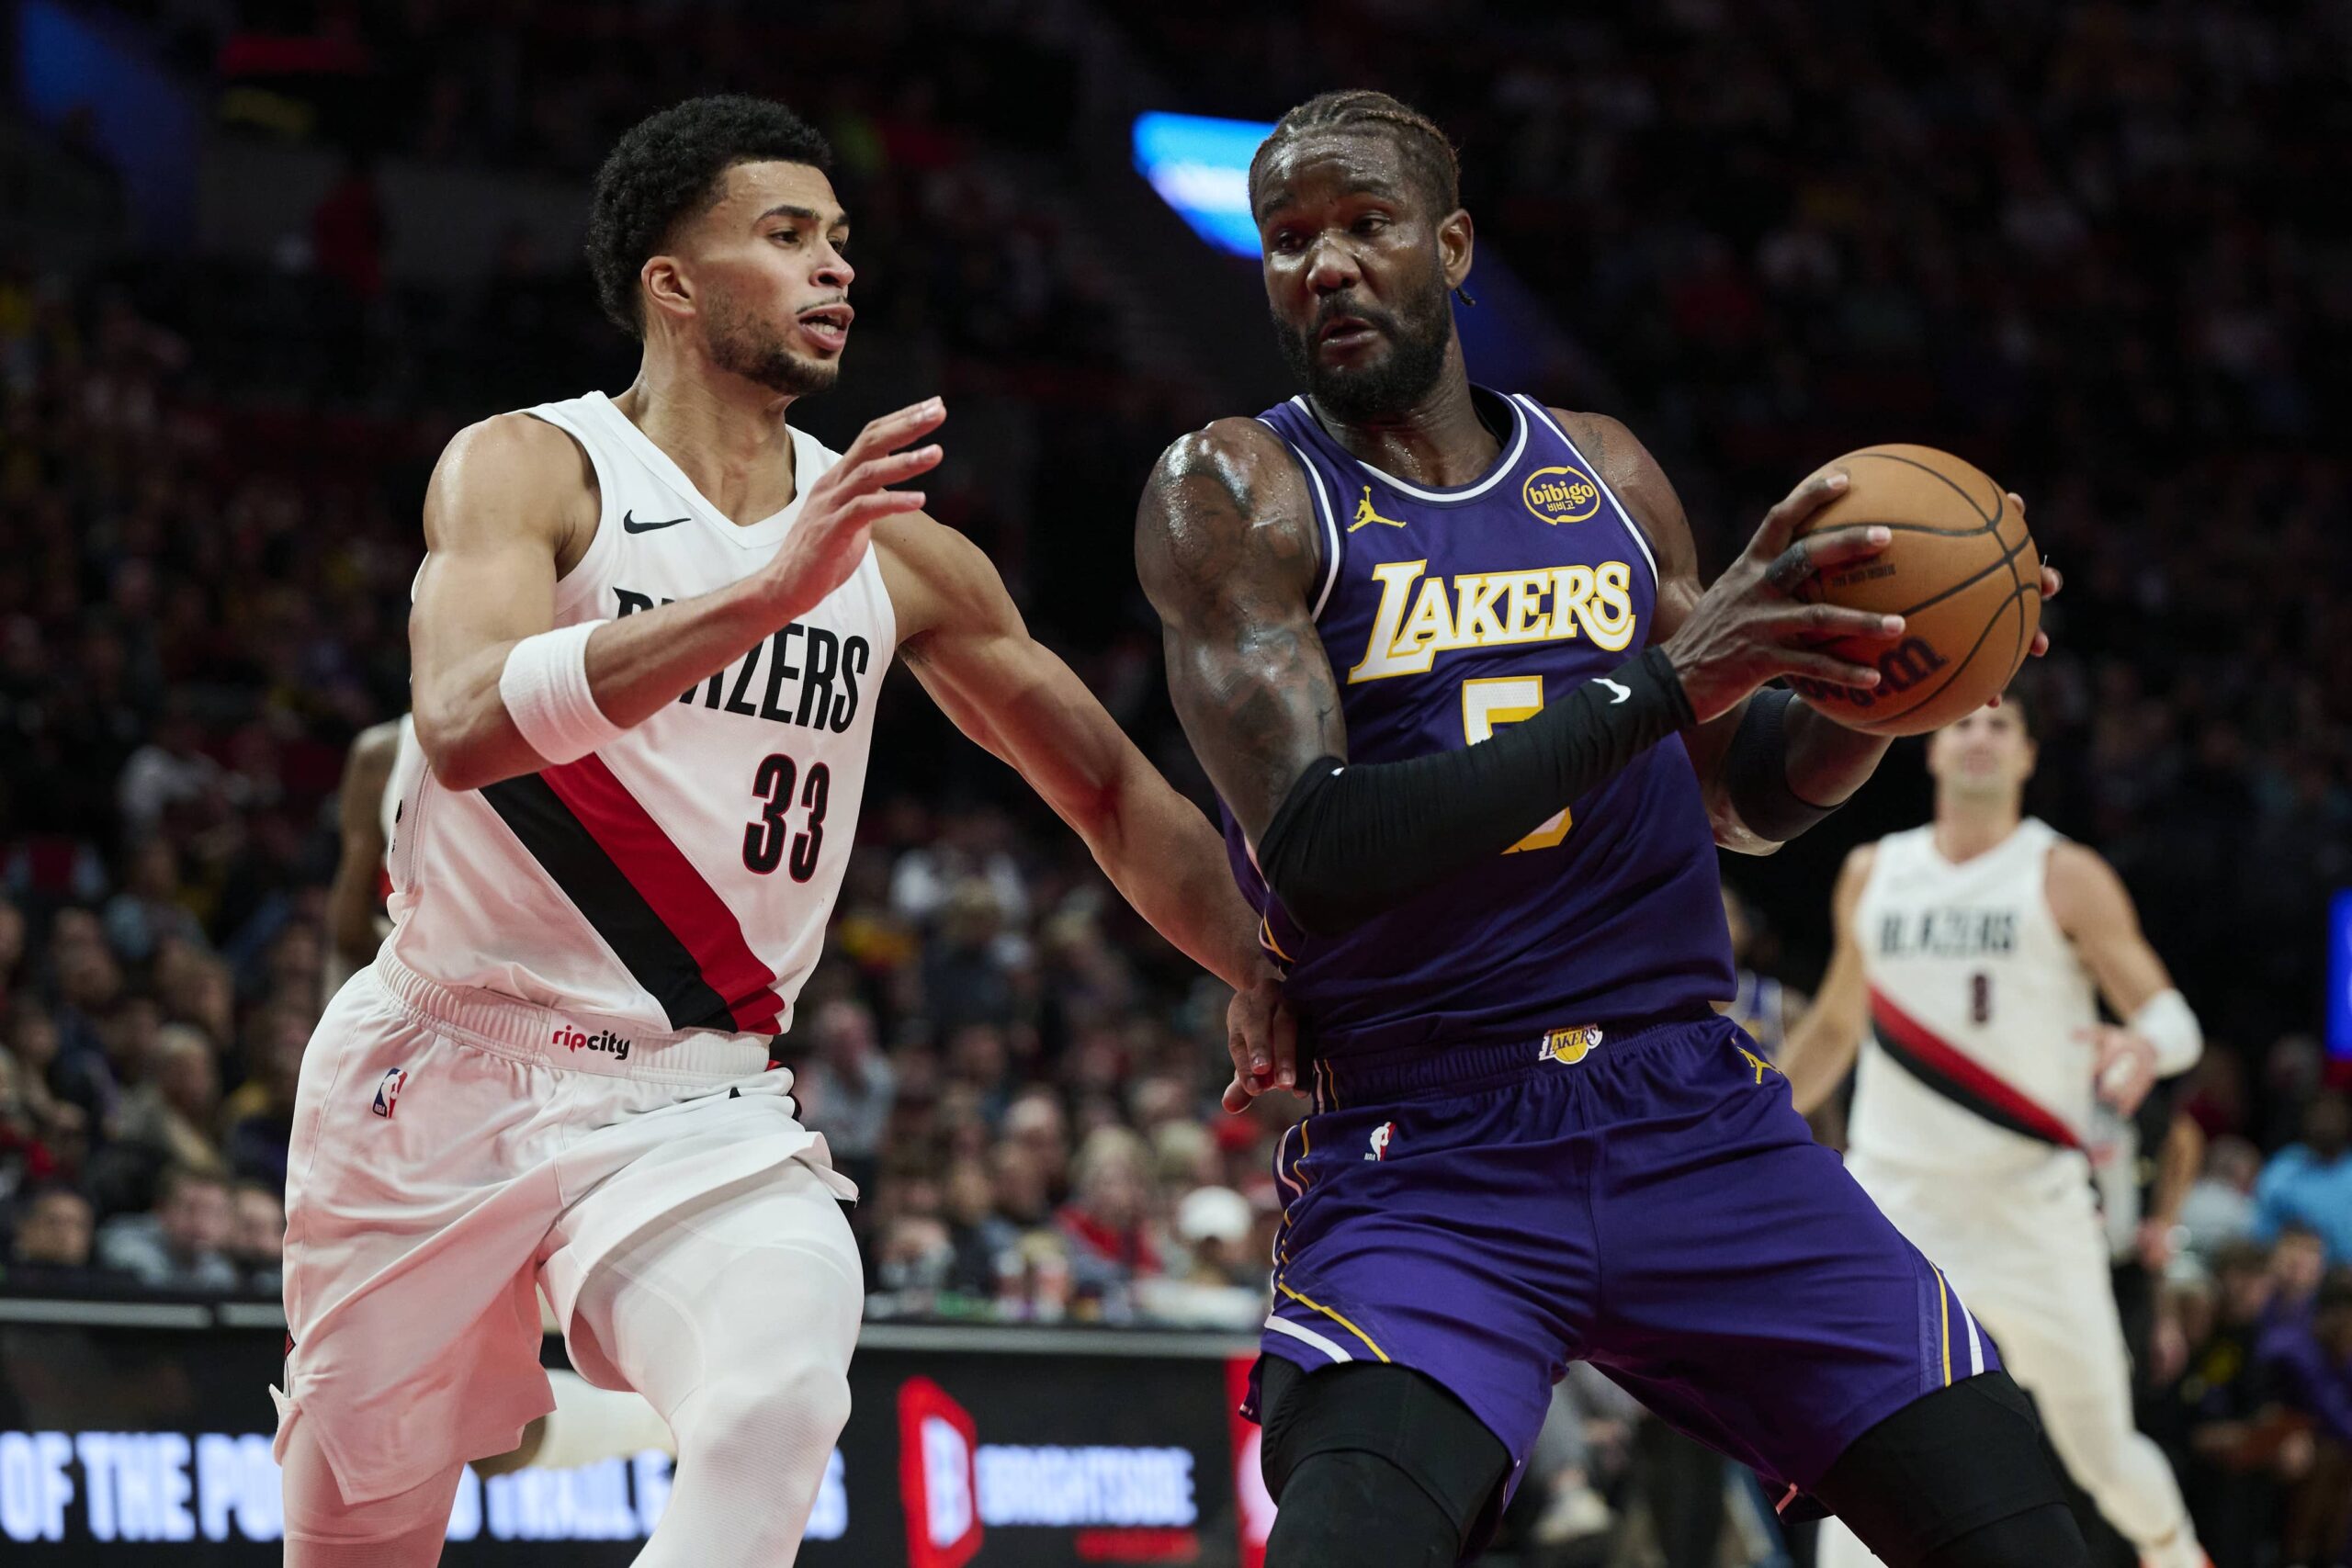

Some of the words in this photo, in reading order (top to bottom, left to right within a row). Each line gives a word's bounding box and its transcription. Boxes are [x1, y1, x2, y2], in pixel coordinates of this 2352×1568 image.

[1528, 479, 1595, 504] bibigo
[1547, 500, 1577, 513] 비비고
[1347, 558, 1635, 685] LAKERS
[613, 586, 870, 734] ZERS
[741, 753, 831, 884] 33
[552, 1024, 631, 1061] ripcity
[1540, 1024, 1600, 1058] LAKERS
[0, 1430, 74, 1542] OF
[74, 1431, 196, 1542] THE
